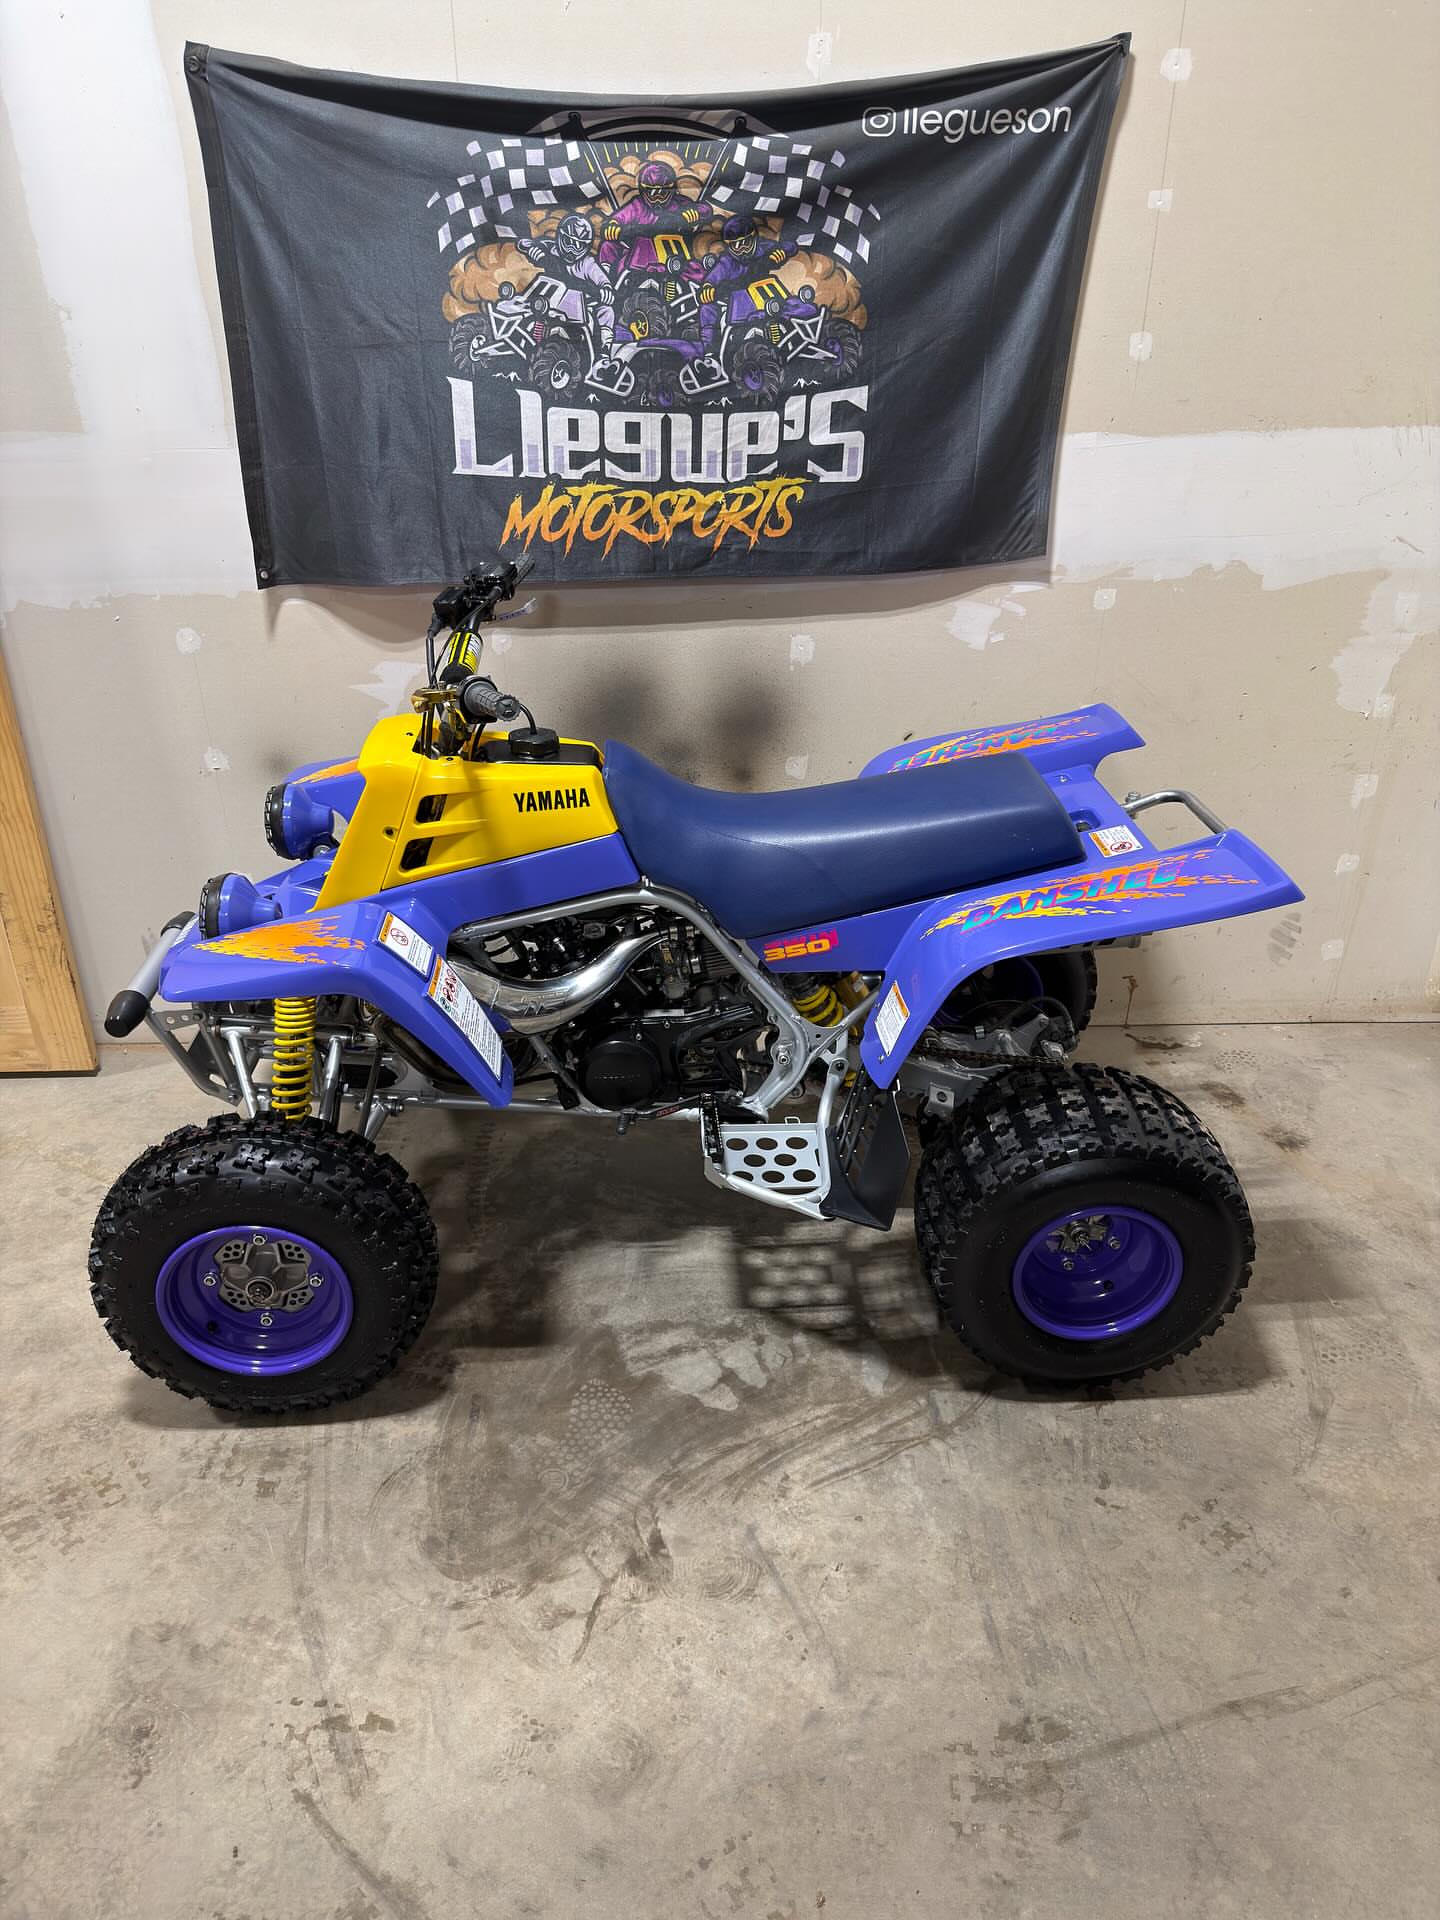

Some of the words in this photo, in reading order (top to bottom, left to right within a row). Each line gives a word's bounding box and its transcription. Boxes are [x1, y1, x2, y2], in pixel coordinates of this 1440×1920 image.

[499, 474, 813, 561] MOTORSPORTS
[513, 787, 591, 813] YAMAHA
[960, 861, 1184, 935] BANSHEE
[763, 938, 831, 962] 350
